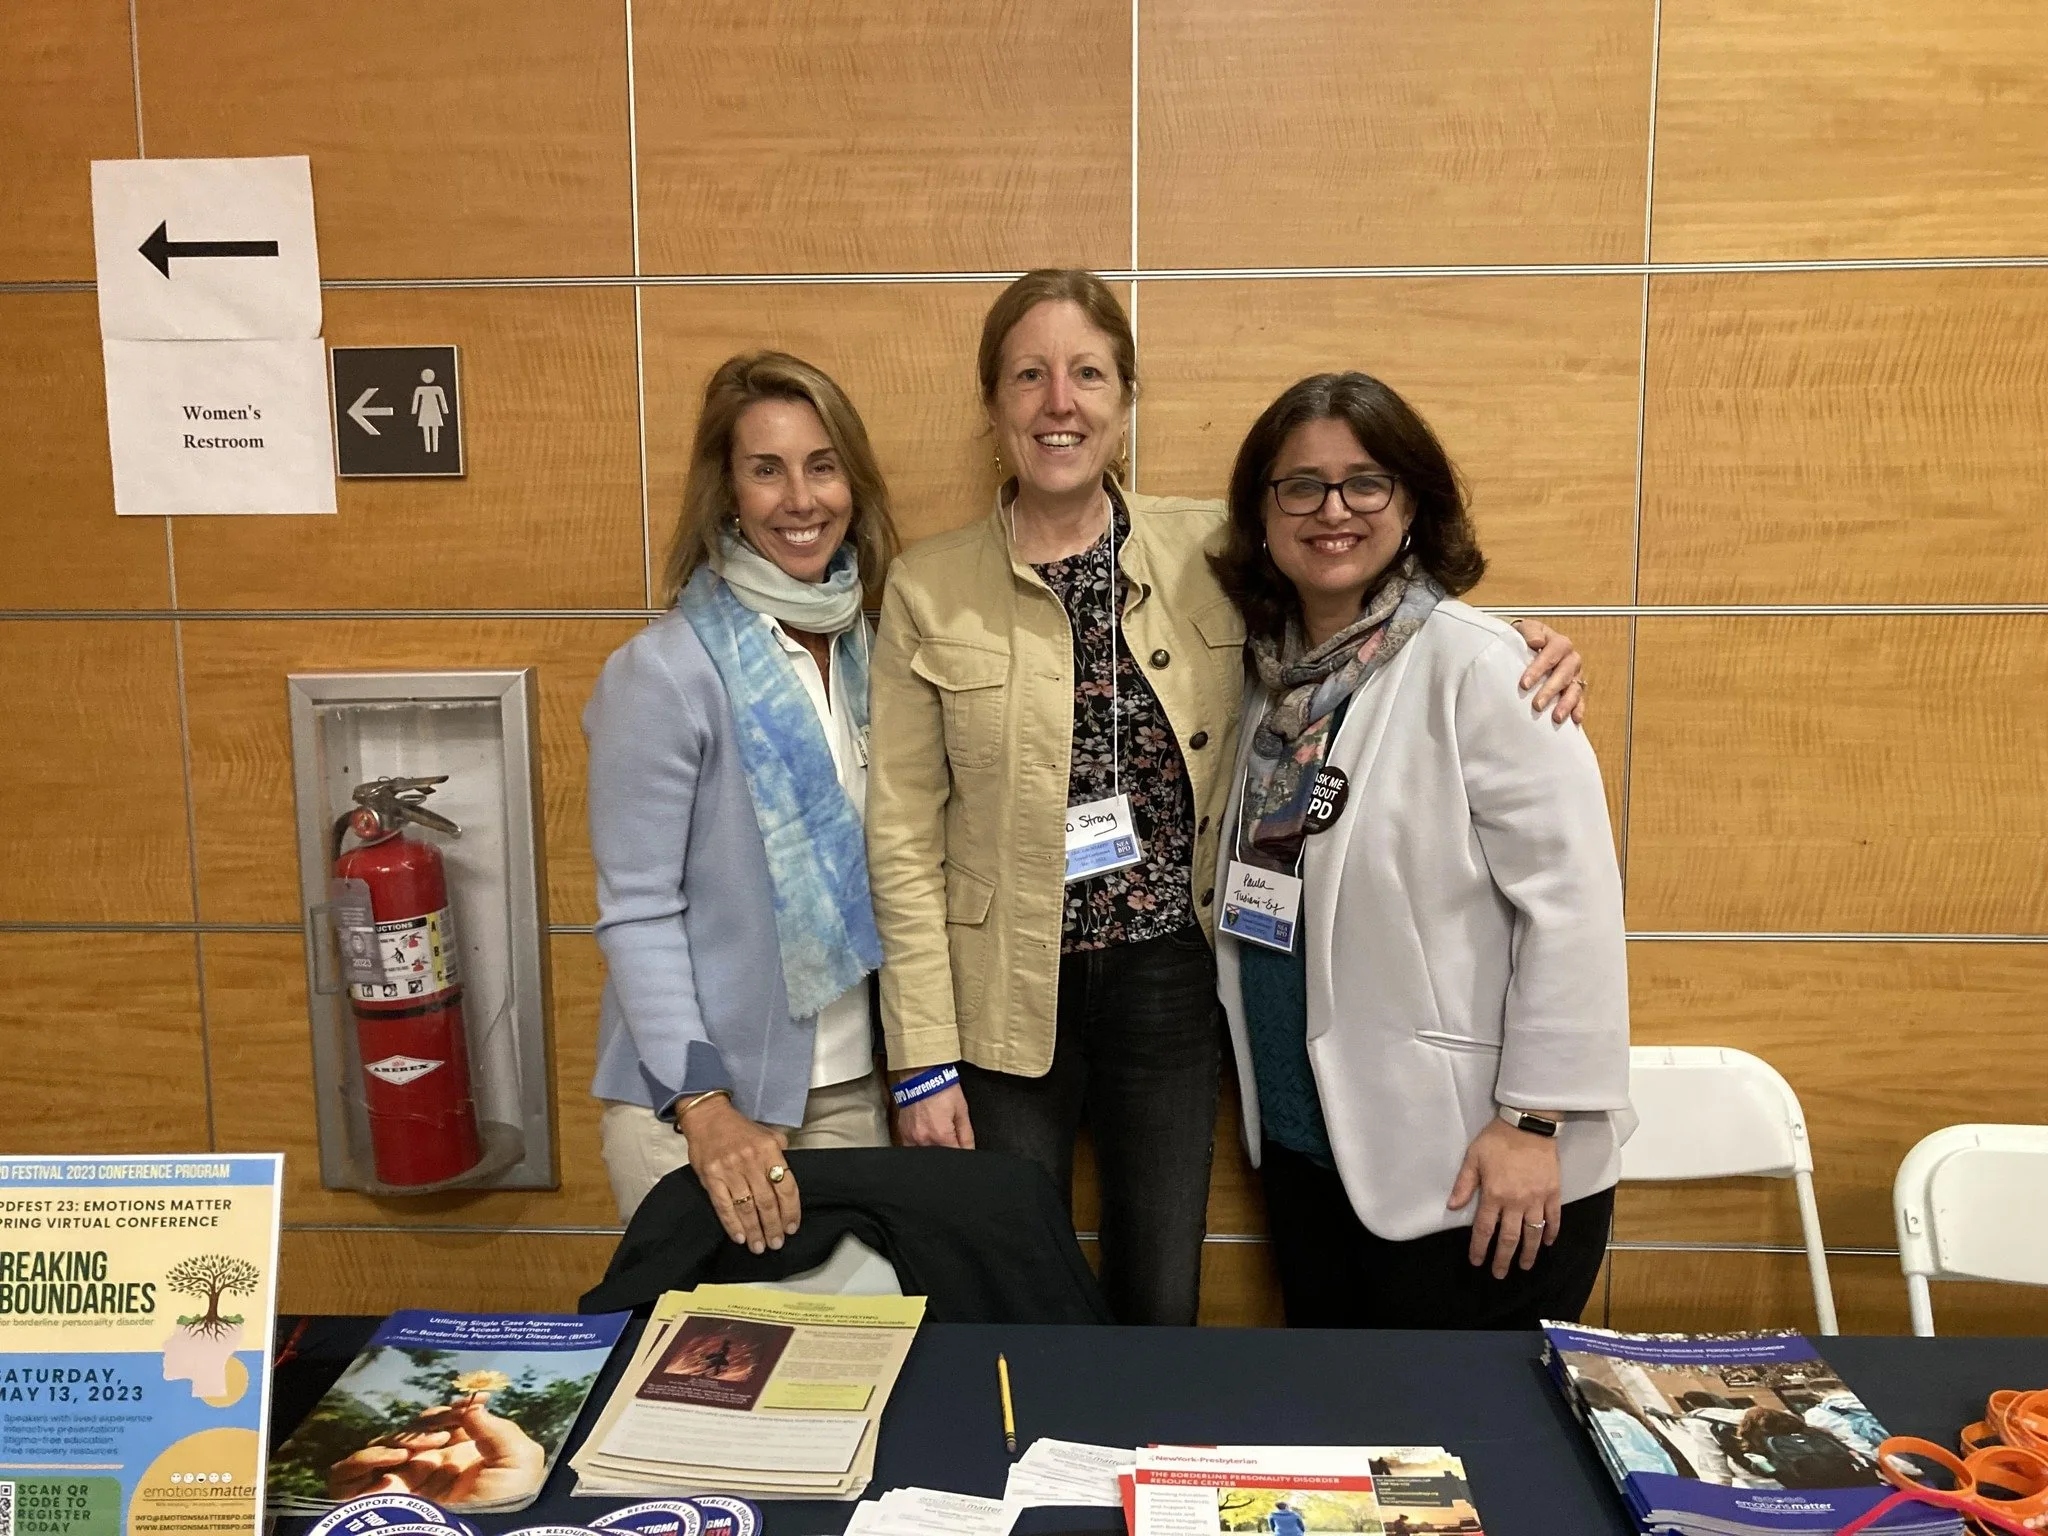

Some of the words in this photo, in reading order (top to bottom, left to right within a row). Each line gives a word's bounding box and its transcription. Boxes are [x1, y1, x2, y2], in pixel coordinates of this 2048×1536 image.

[183, 404, 261, 420] Women's
[183, 434, 264, 449] Restroom
[1329, 777, 1344, 790] ME
[1078, 812, 1118, 837] Strong
[1244, 873, 1274, 890] Paula
[353, 958, 372, 968] 2023
[906, 1074, 944, 1100] Awareness
[12, 1165, 63, 1180] FESTIVAL
[67, 1164, 96, 1179] 2023
[99, 1164, 172, 1179] CONFERENCE
[175, 1164, 230, 1178] PROGRAM
[57, 1201, 79, 1212] 23:
[84, 1200, 165, 1212] EMOTIONS
[171, 1200, 232, 1210] MATTER
[47, 1217, 110, 1228] VIRTUAL
[116, 1216, 218, 1228] CONFERENCE
[0, 1283, 156, 1314] BOUNDARIES
[728, 1304, 800, 1316] UNDERSTANDING
[14, 1318, 58, 1326] borderline
[62, 1317, 114, 1328] personality
[116, 1317, 154, 1326] disorder
[430, 1318, 468, 1326] Utilizing
[420, 1329, 468, 1338] Borderline
[0, 1368, 122, 1385] ATURDAY,
[49, 1386, 78, 1404] 13,
[88, 1386, 143, 1401] 2023
[4, 1414, 48, 1424] Speakers
[50, 1414, 71, 1422] with
[74, 1414, 96, 1422] lived
[98, 1415, 154, 1424] experience
[57, 1425, 124, 1436] presentations
[4, 1436, 61, 1446] Stigma-free
[64, 1436, 114, 1444] education
[26, 1448, 67, 1456] recovery
[1171, 1472, 1228, 1480] BORDERLINE
[1230, 1474, 1290, 1482] PERSONALITY
[18, 1484, 60, 1495] SCAN
[68, 1485, 88, 1496] QR
[18, 1497, 60, 1508] CODE
[67, 1498, 86, 1508] TO
[626, 1503, 682, 1514] RESOURCES
[18, 1510, 90, 1520] REGISTER
[322, 1513, 342, 1528] BPD
[344, 1498, 395, 1514] SUPPORT
[18, 1522, 70, 1532] TODAY
[376, 1524, 440, 1536] RESOURCES
